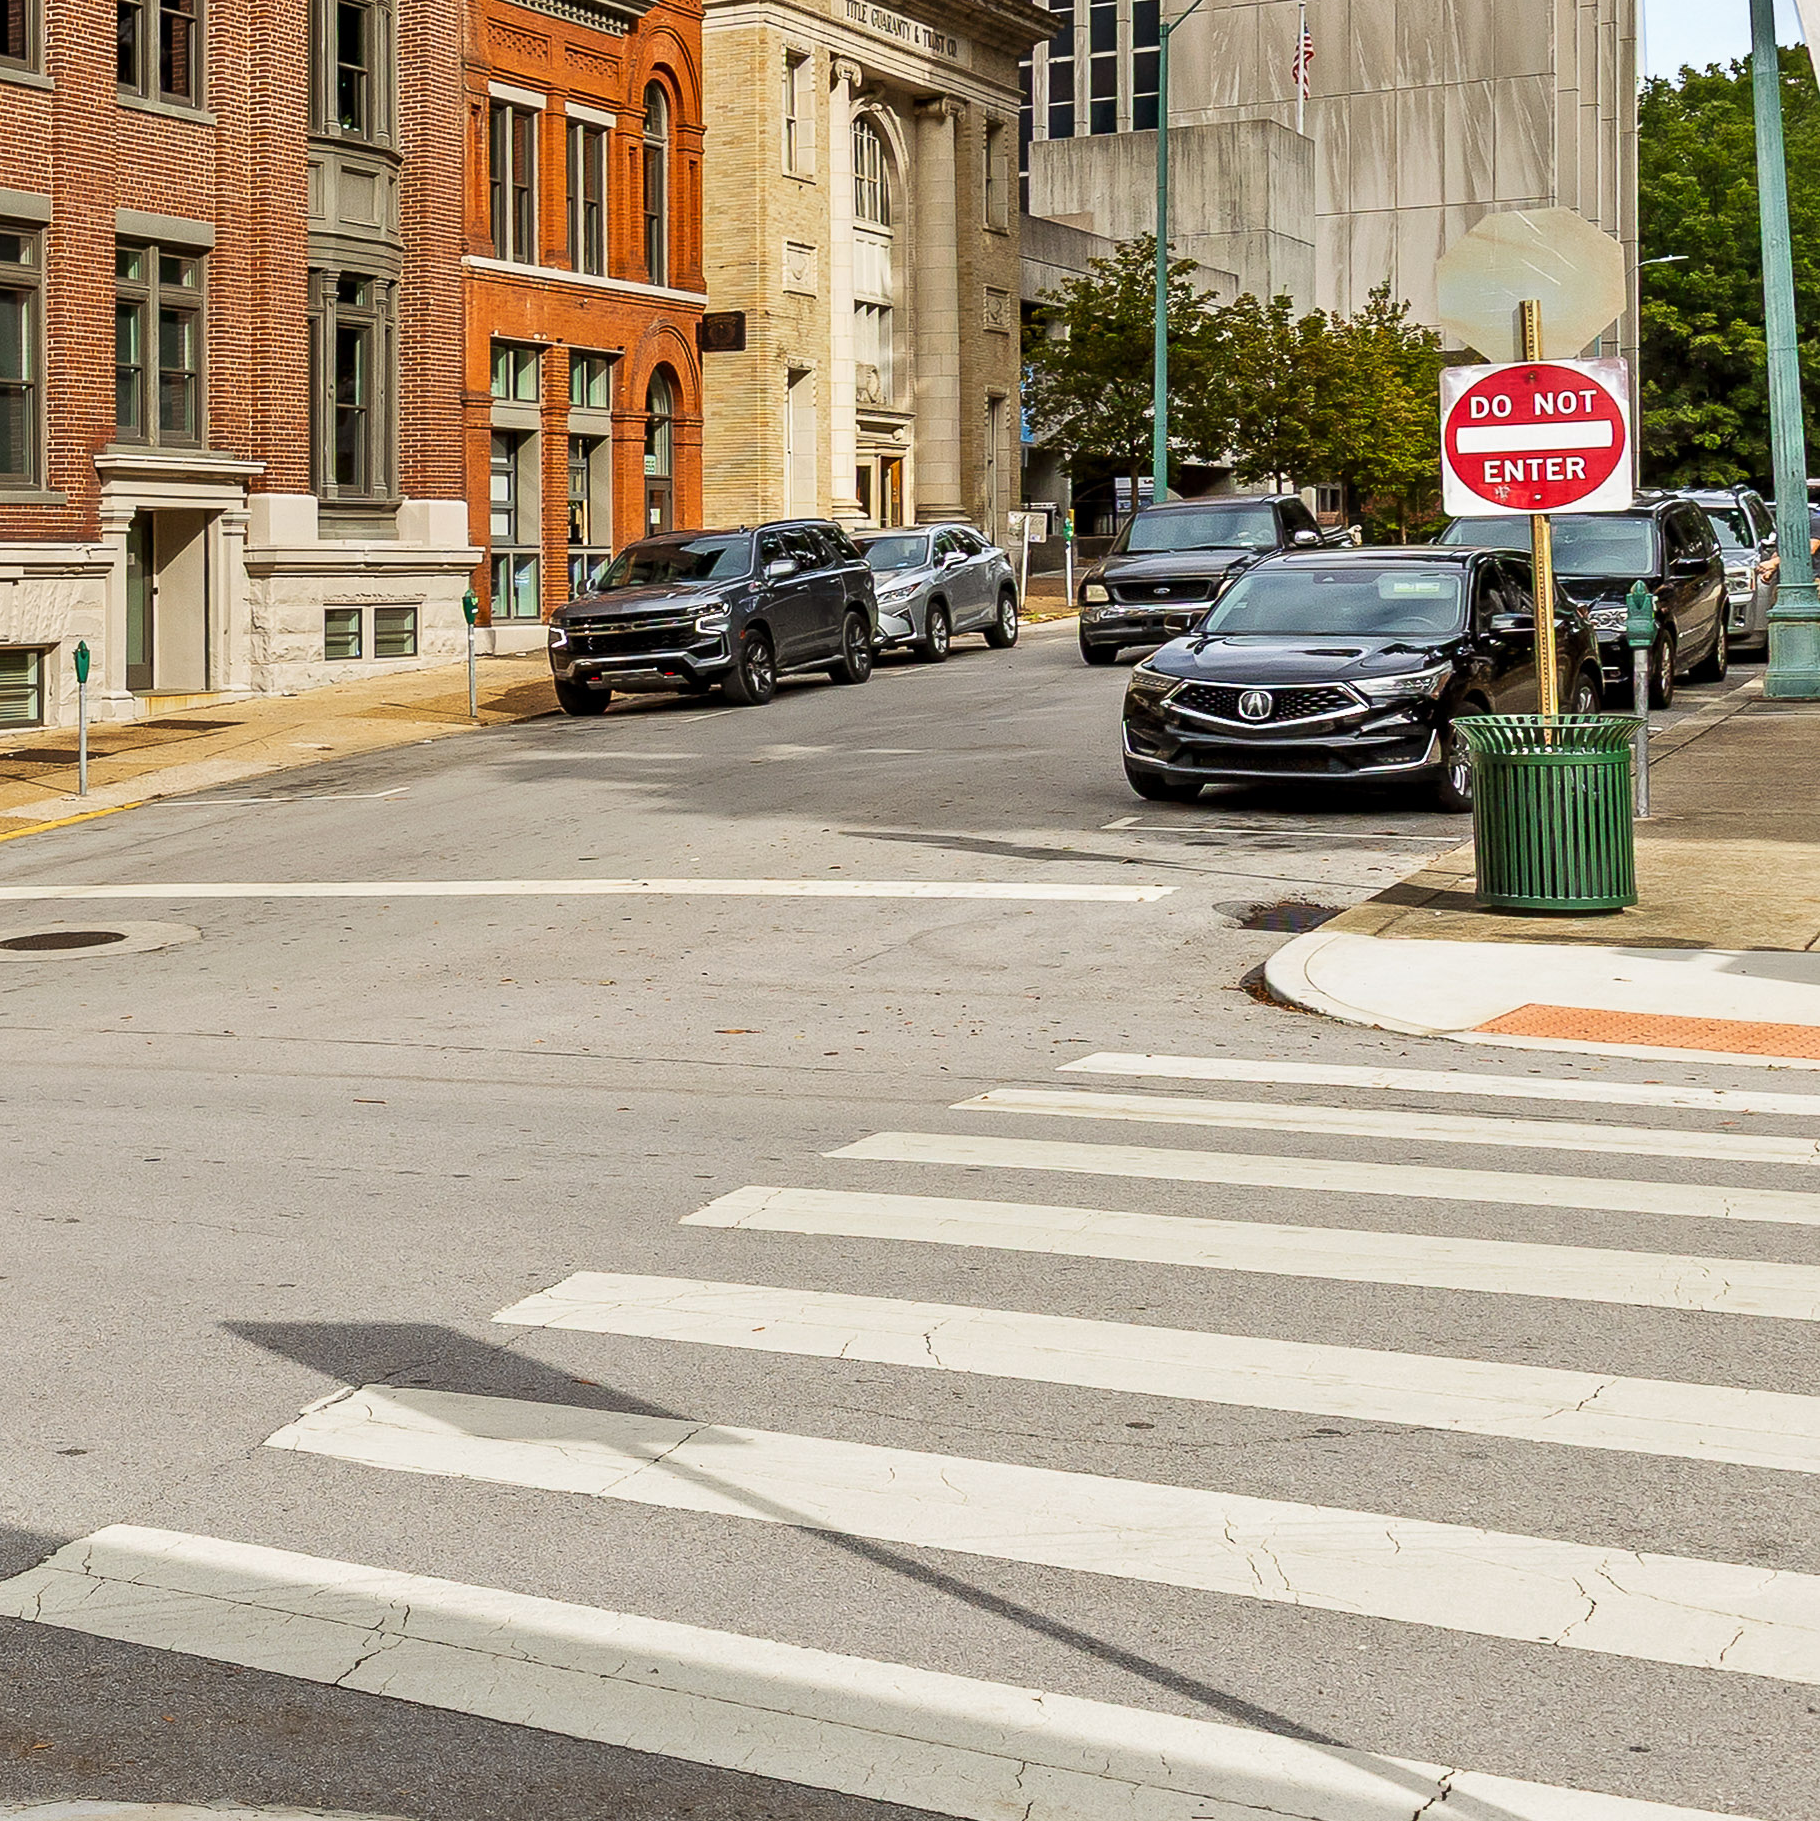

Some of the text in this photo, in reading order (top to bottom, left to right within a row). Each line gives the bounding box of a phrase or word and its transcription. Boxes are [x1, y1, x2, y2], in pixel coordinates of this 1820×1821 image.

[922, 28, 946, 54] TRUST
[1470, 389, 1598, 419] DO NOT
[1483, 456, 1587, 484] ENTER
